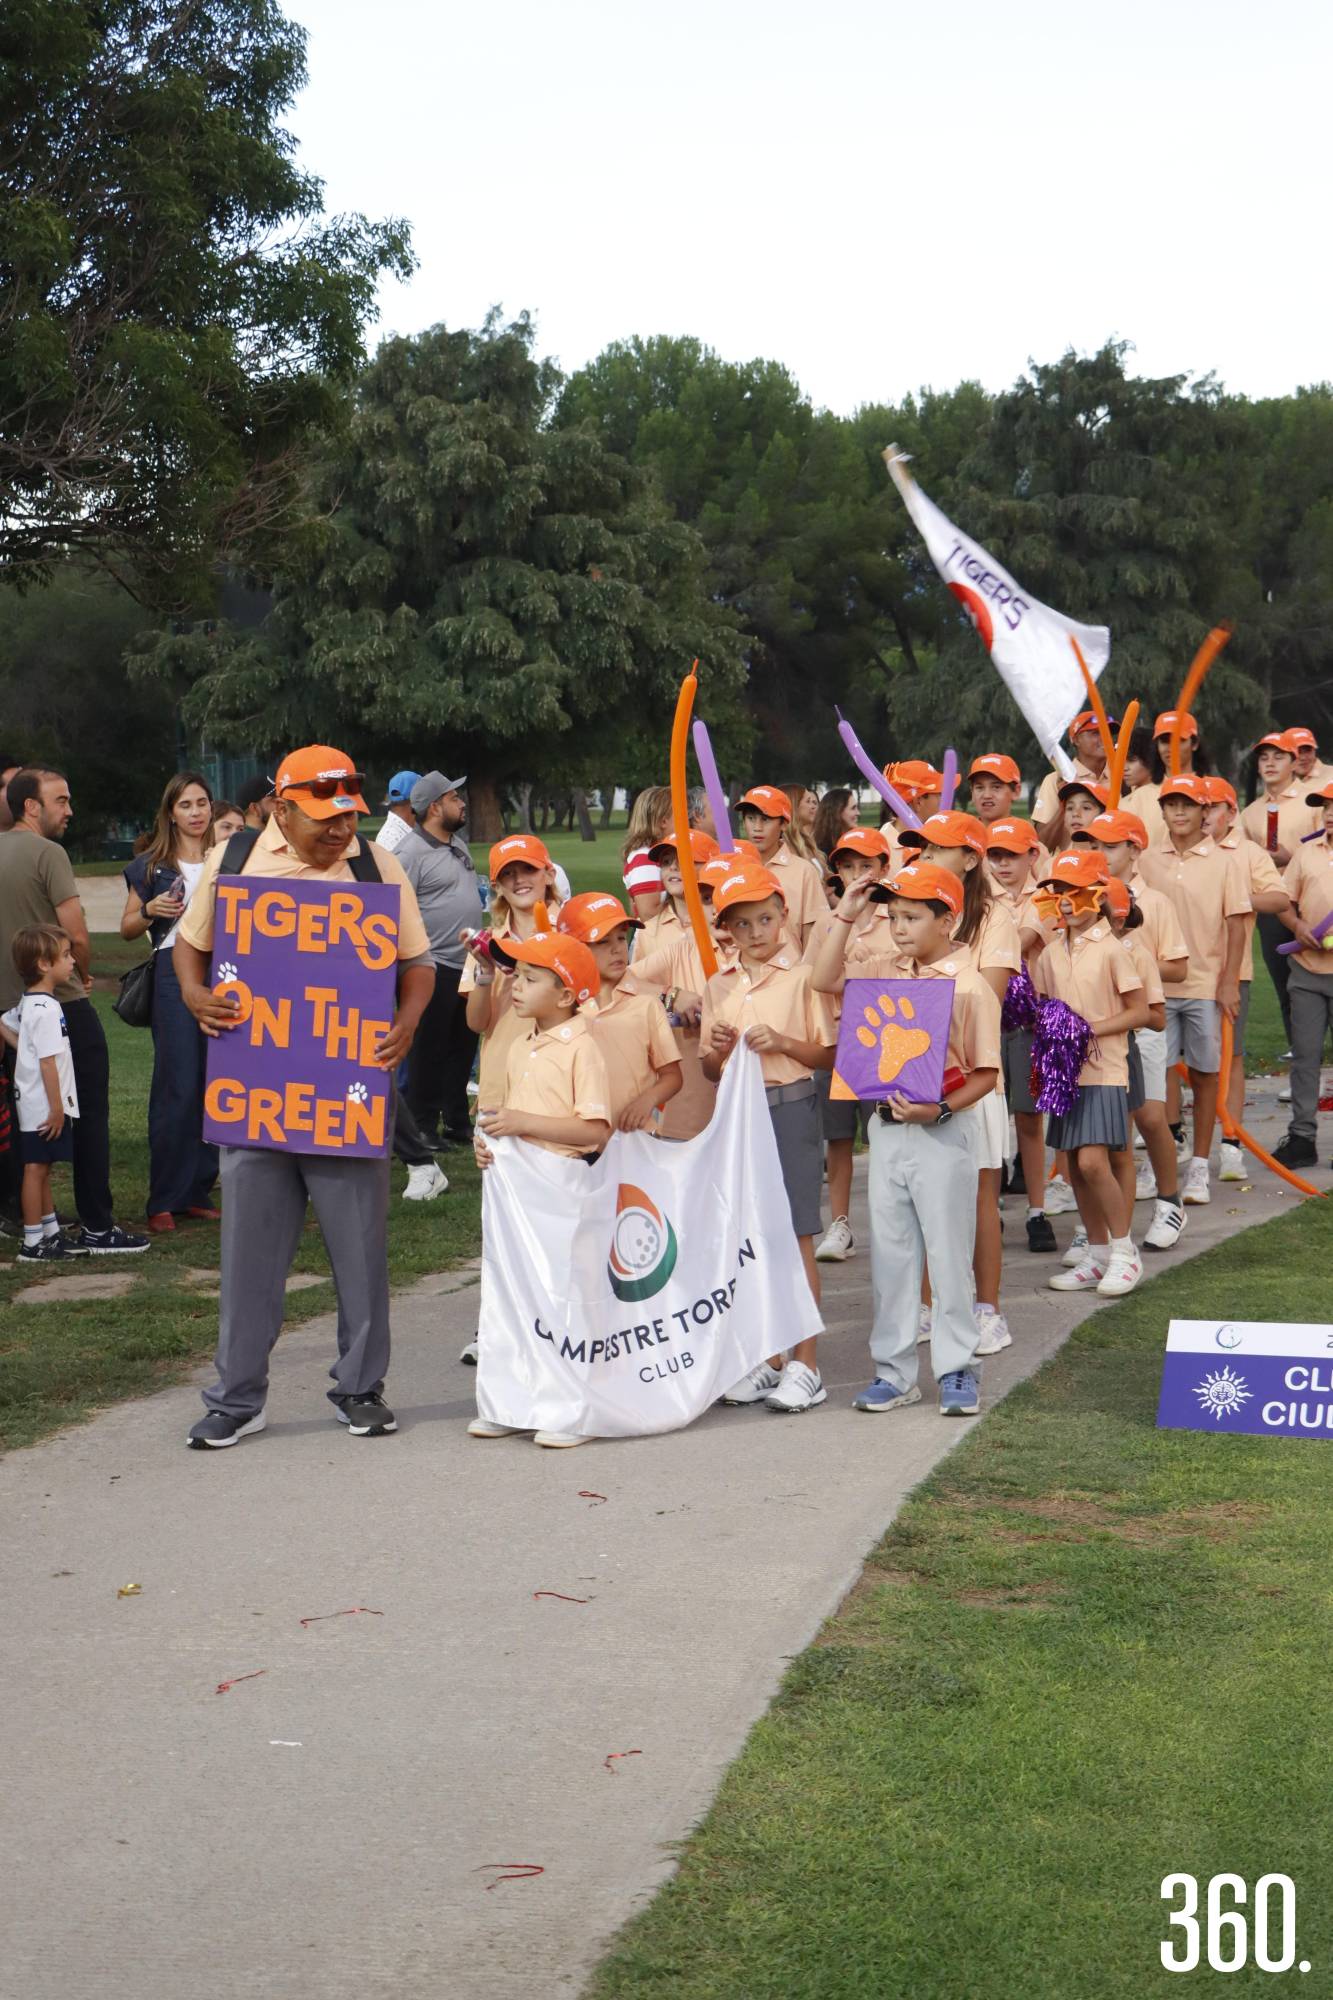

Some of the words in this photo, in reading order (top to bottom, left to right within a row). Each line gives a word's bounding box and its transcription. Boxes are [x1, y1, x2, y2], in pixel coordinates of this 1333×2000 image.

[944, 541, 1030, 631] TIGERS
[217, 886, 398, 970] TIGERS
[211, 980, 291, 1048] ON
[304, 986, 391, 1067] THE
[204, 1078, 386, 1147] GREEN
[534, 1318, 669, 1363] CMPESTRE
[639, 1351, 694, 1383] CLUB
[1284, 1366, 1333, 1392] CL
